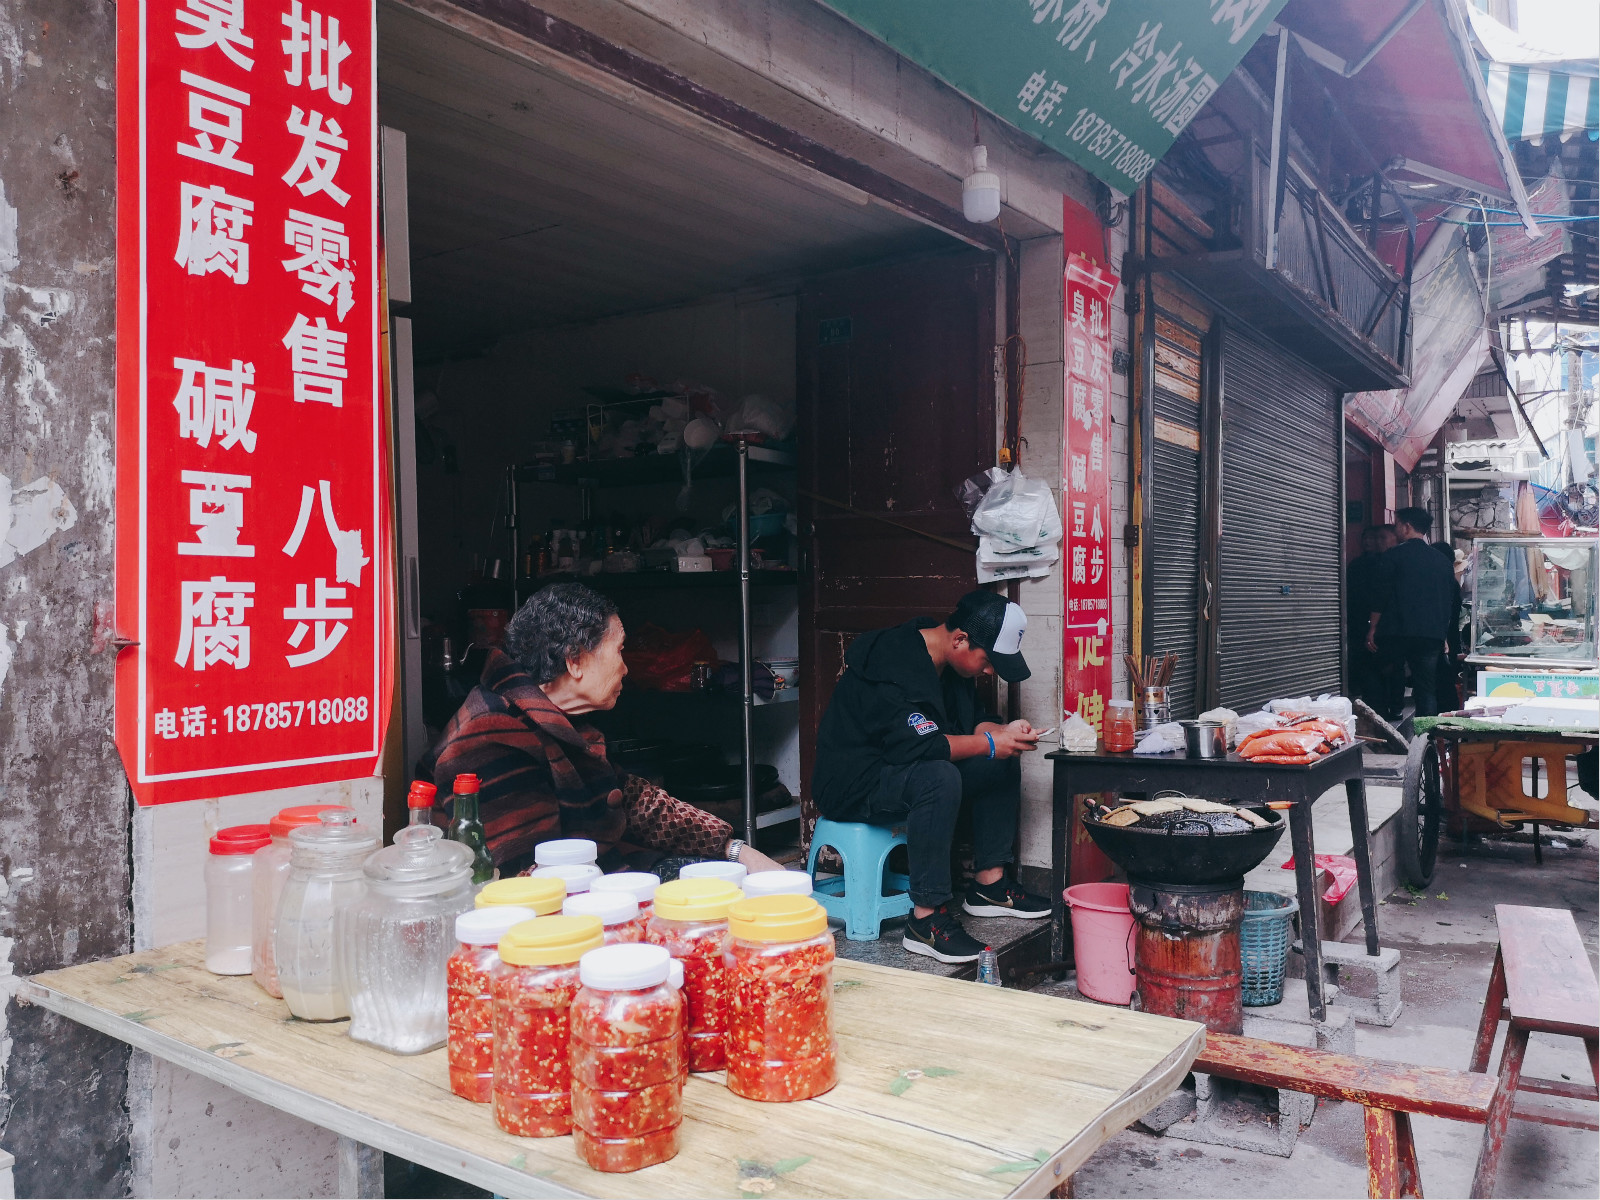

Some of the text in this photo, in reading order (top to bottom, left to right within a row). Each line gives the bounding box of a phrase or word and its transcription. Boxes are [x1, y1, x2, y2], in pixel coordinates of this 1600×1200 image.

[1029, 0, 1219, 139] 粉、冷水汤圆
[172, 0, 258, 672] 臭豆腐 碱豆腐
[281, 0, 356, 669] 批发零售 八步
[1071, 290, 1086, 421] 臭豆腐
